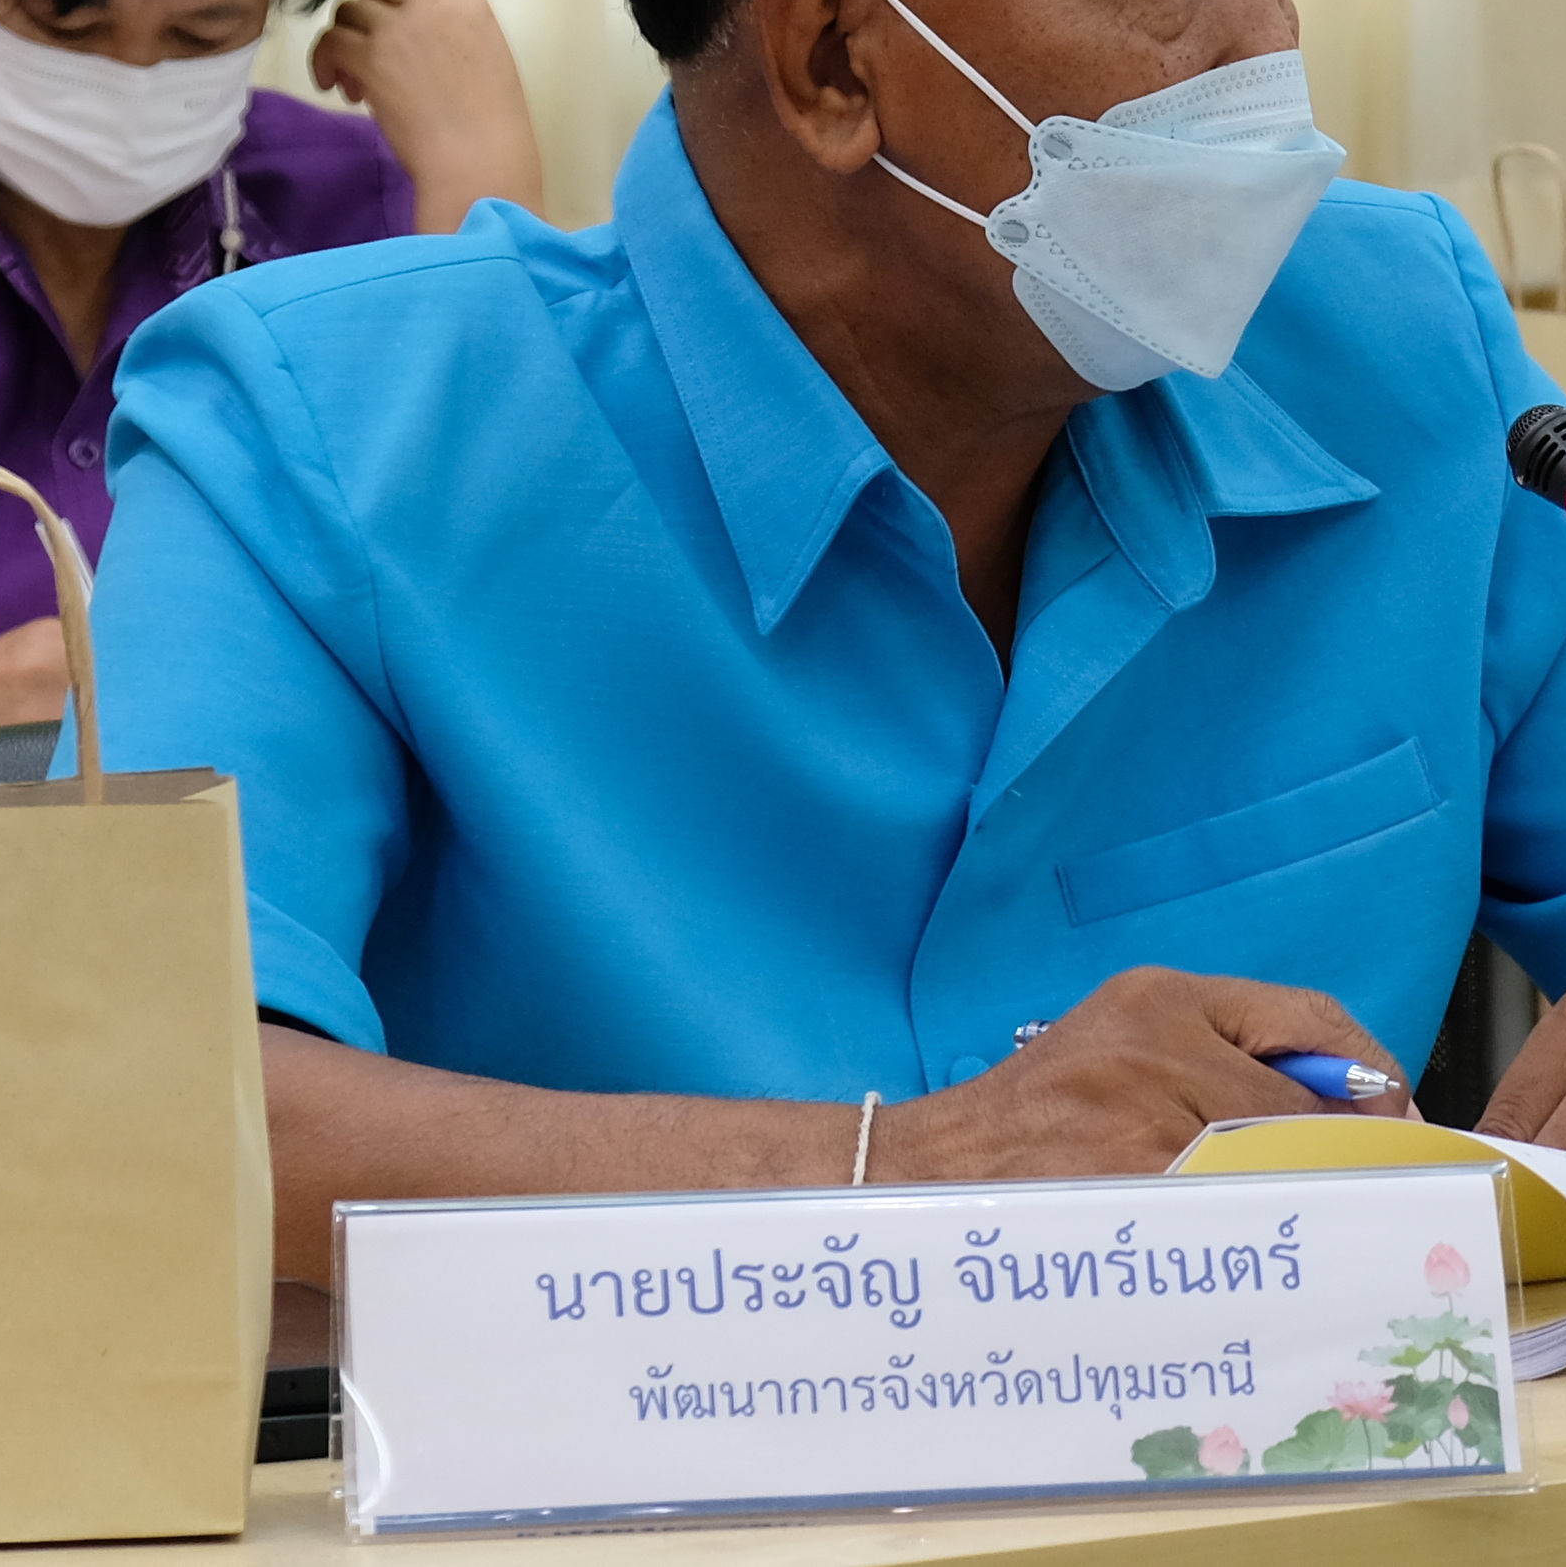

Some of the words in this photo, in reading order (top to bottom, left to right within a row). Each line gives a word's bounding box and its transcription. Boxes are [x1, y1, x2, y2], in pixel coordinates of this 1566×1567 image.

[535, 1233, 924, 1332] นายประจัญ
[954, 1213, 1303, 1305] จันทร์เนตร์
[628, 1339, 1258, 1423] พัฒนาการจังหวัดปทุมธานี
